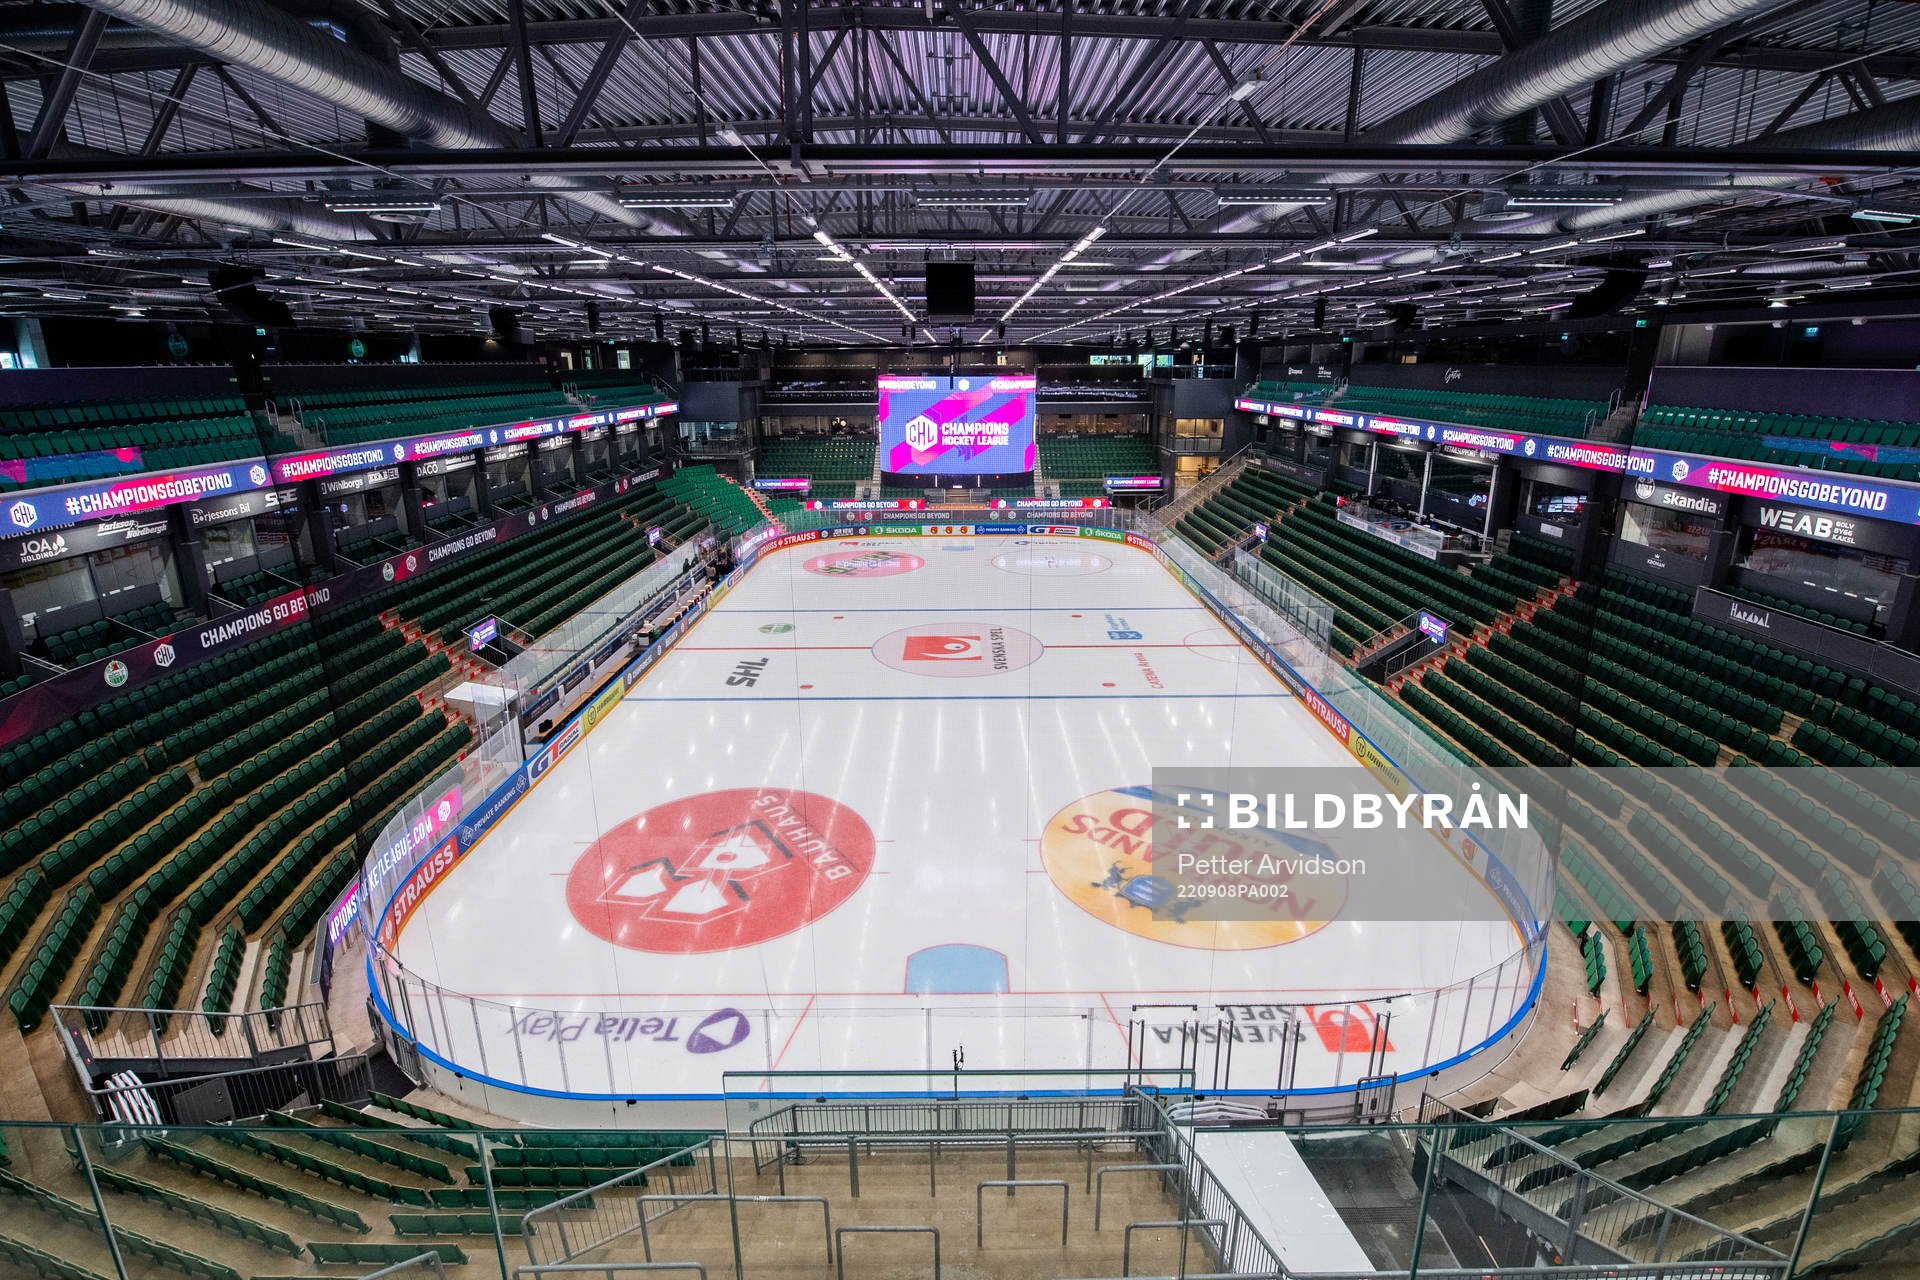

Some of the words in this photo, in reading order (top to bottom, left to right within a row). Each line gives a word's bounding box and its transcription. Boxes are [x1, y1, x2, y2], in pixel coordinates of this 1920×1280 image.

[908, 420, 935, 447] CHL
[941, 422, 1009, 435] CHAMPIONS
[941, 436, 975, 446] HOCKEY
[977, 436, 1009, 446] LEAGUE
[1442, 430, 1514, 451] #CHAMPIONSGOBEYOND
[415, 433, 483, 455] #CHAMPIONSGOBEYOND
[282, 449, 383, 478] #CHAMPIONSGOBEYOND
[1547, 444, 1656, 473] #CHAMPIONSGOBEYOND
[65, 472, 232, 515] #CHAMPIONSGOBEYOND
[326, 477, 364, 493] Wihlborgs
[1708, 467, 1888, 512] #CHAMPIONSGOBEYOND
[833, 500, 866, 508] CHAMPIONS
[867, 500, 875, 508] GO
[876, 500, 899, 508] BEYOND
[884, 512, 917, 520] CHAMPIONS
[927, 511, 950, 519] BEYOND
[1026, 511, 1059, 519] CHAMPIONS
[886, 526, 917, 534] ŠKODA
[1094, 529, 1122, 540] ŠKODA
[1760, 507, 1833, 538] WEAB
[20, 538, 52, 557] JOA
[429, 538, 466, 562] CHAMPIONS
[466, 537, 475, 548] GO
[475, 527, 497, 544] BEYOND
[784, 532, 816, 545] STRAUSS
[21, 551, 54, 564] HOLDING
[200, 609, 272, 648] CHAMPIONS
[273, 602, 290, 621] GO
[291, 588, 330, 615] BEYOND
[990, 627, 1004, 640] SPEL
[991, 642, 1008, 670] SVENSKA
[725, 657, 769, 687] SHL
[1311, 694, 1348, 740] STRAUSS
[530, 720, 580, 780] GT
[473, 809, 494, 832] PRIVATE
[494, 788, 516, 812] BANKING
[755, 794, 852, 882] BAUHAUS
[393, 844, 454, 925] STRAUSS
[506, 1012, 591, 1044] Play
[594, 1016, 679, 1042] Telia
[1152, 1023, 1306, 1045] SVENSKA
